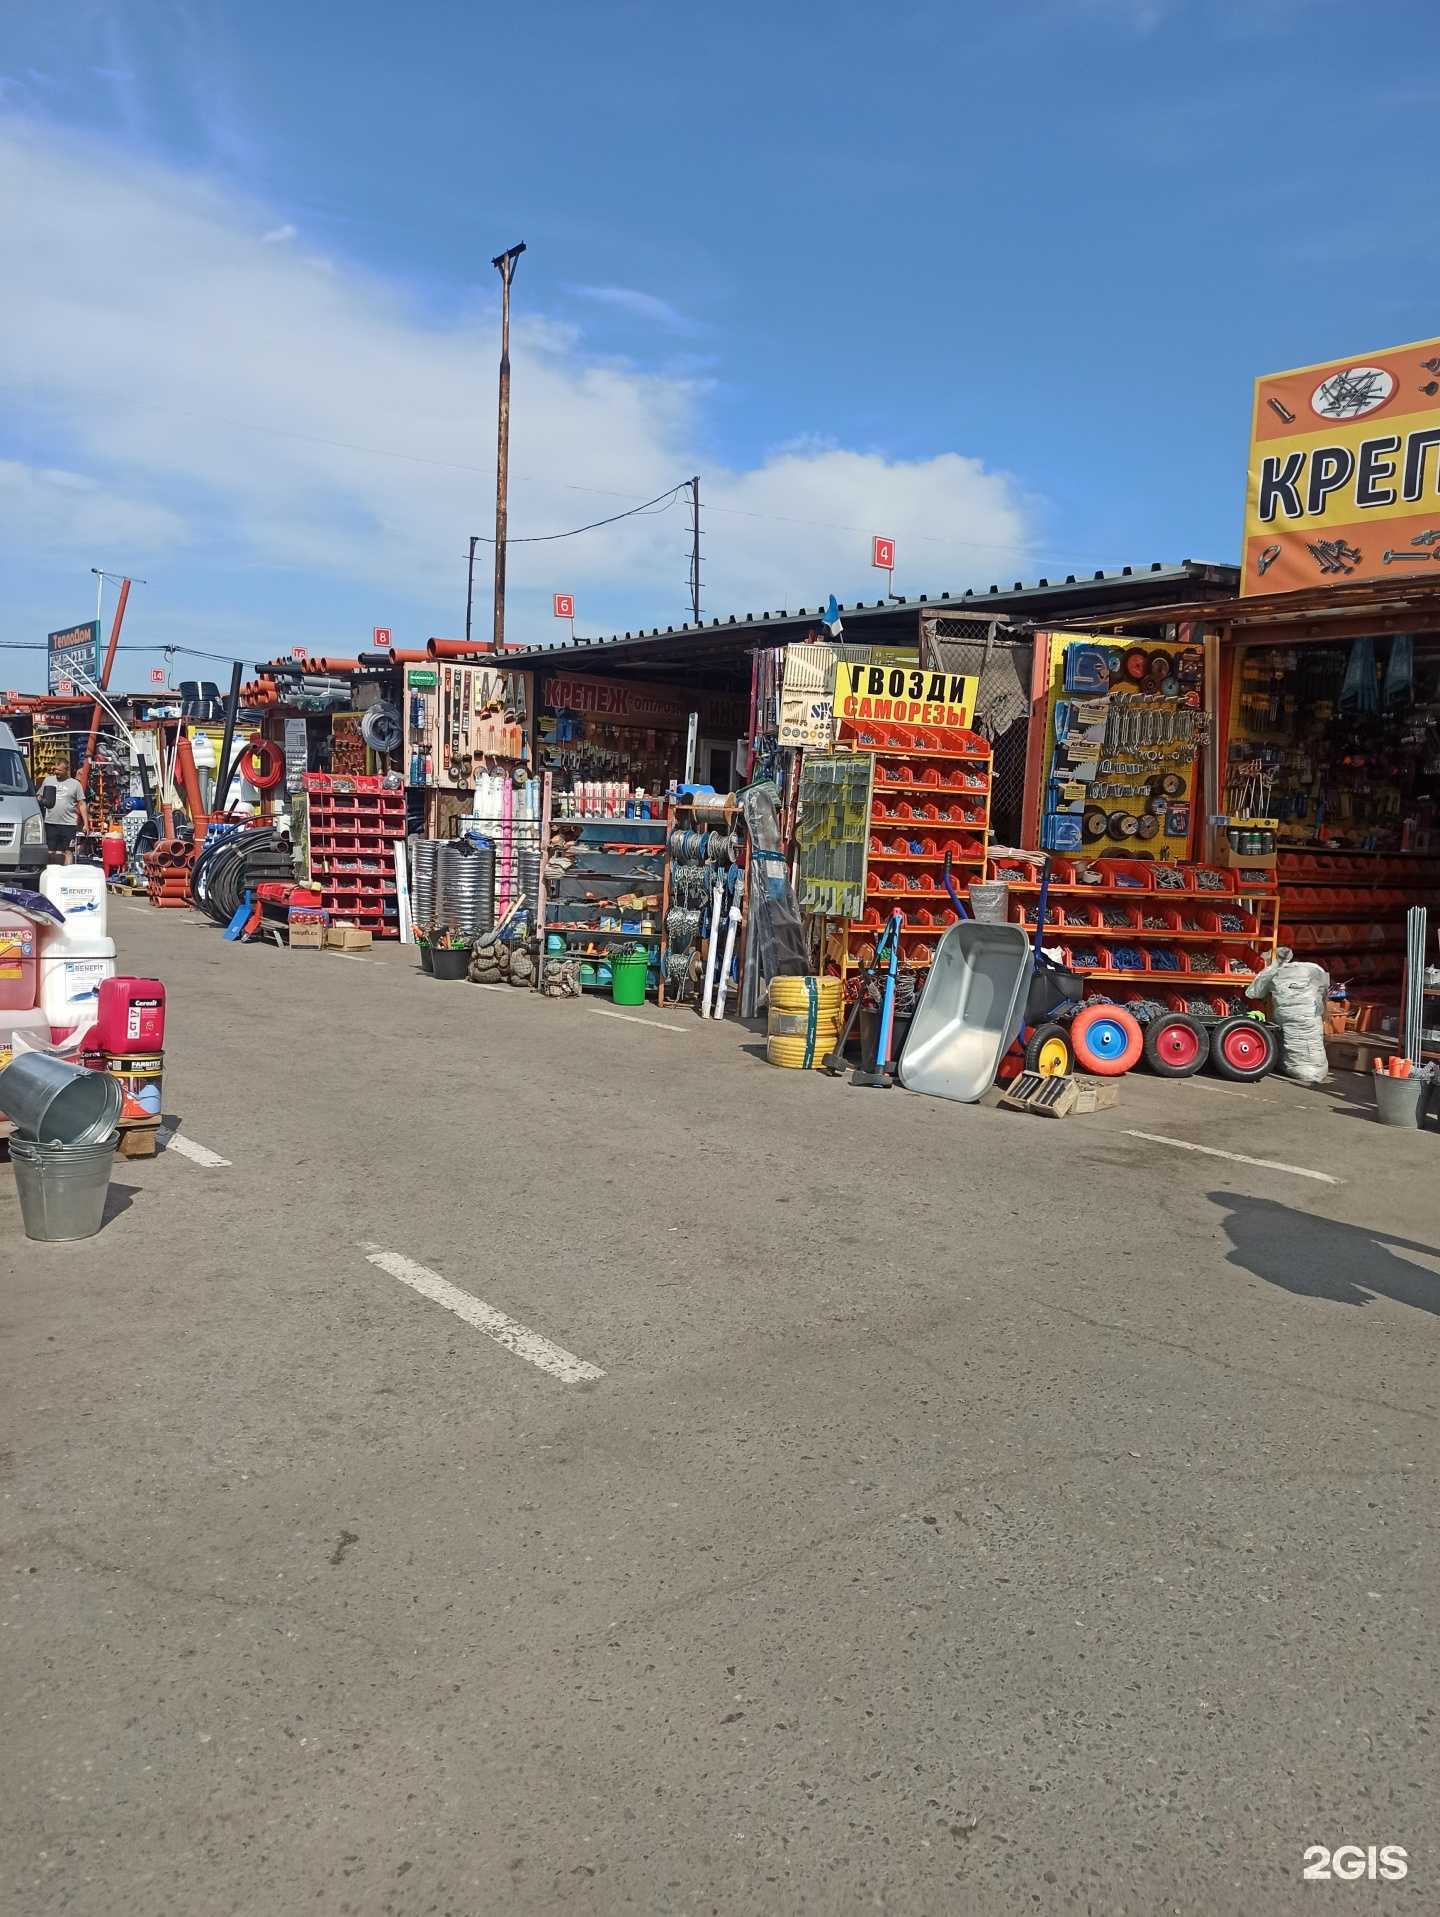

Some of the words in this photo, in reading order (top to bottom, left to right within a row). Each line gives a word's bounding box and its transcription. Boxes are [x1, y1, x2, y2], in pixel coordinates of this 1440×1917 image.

[1259, 428, 1440, 522] КРЕП
[545, 678, 630, 715] КРЕПЕЖ
[851, 665, 965, 704] ГВОЗДИ
[843, 695, 967, 727] САМОРЕЗЫ
